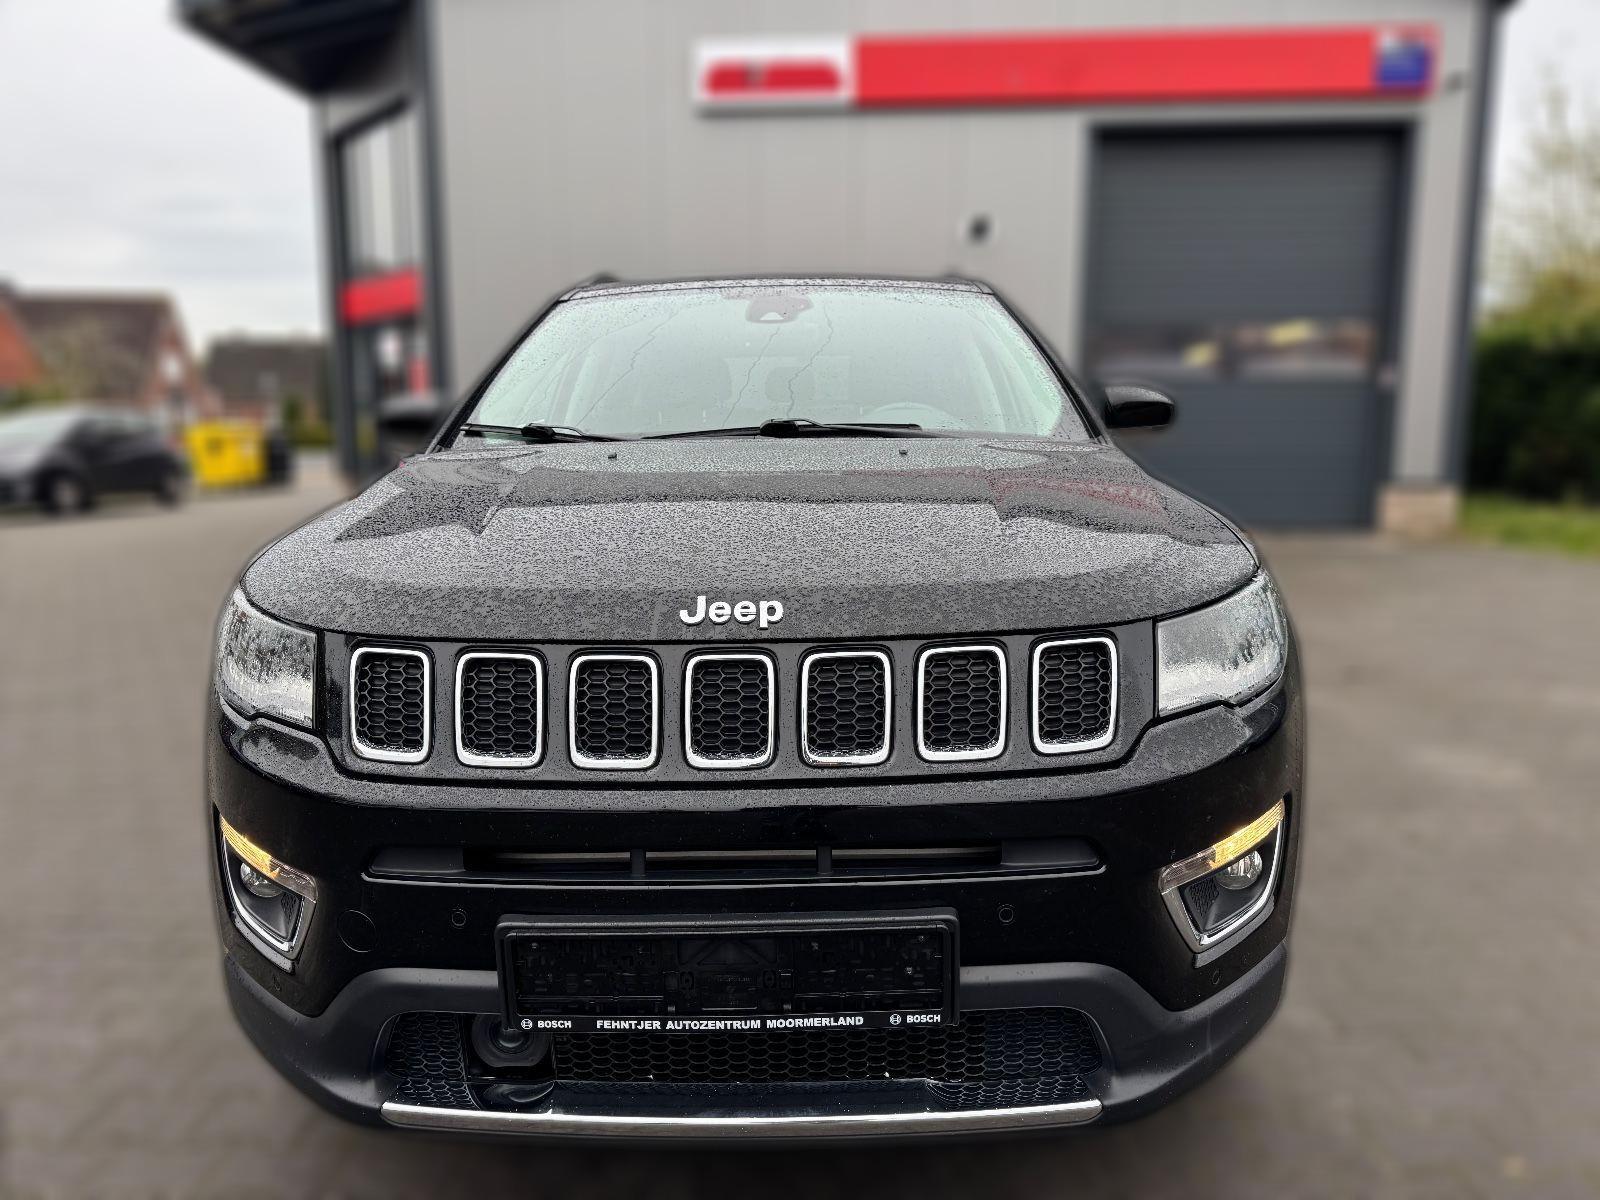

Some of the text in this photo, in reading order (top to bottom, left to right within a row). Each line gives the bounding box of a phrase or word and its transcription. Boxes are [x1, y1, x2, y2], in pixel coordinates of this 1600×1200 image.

[679, 595, 784, 629] Jeep
[596, 1016, 864, 1030] FEHNTJER AUTOZENTRUM MOORMERLAND
[906, 1014, 941, 1023] BOSCH
[537, 1020, 572, 1029] BOSCH
